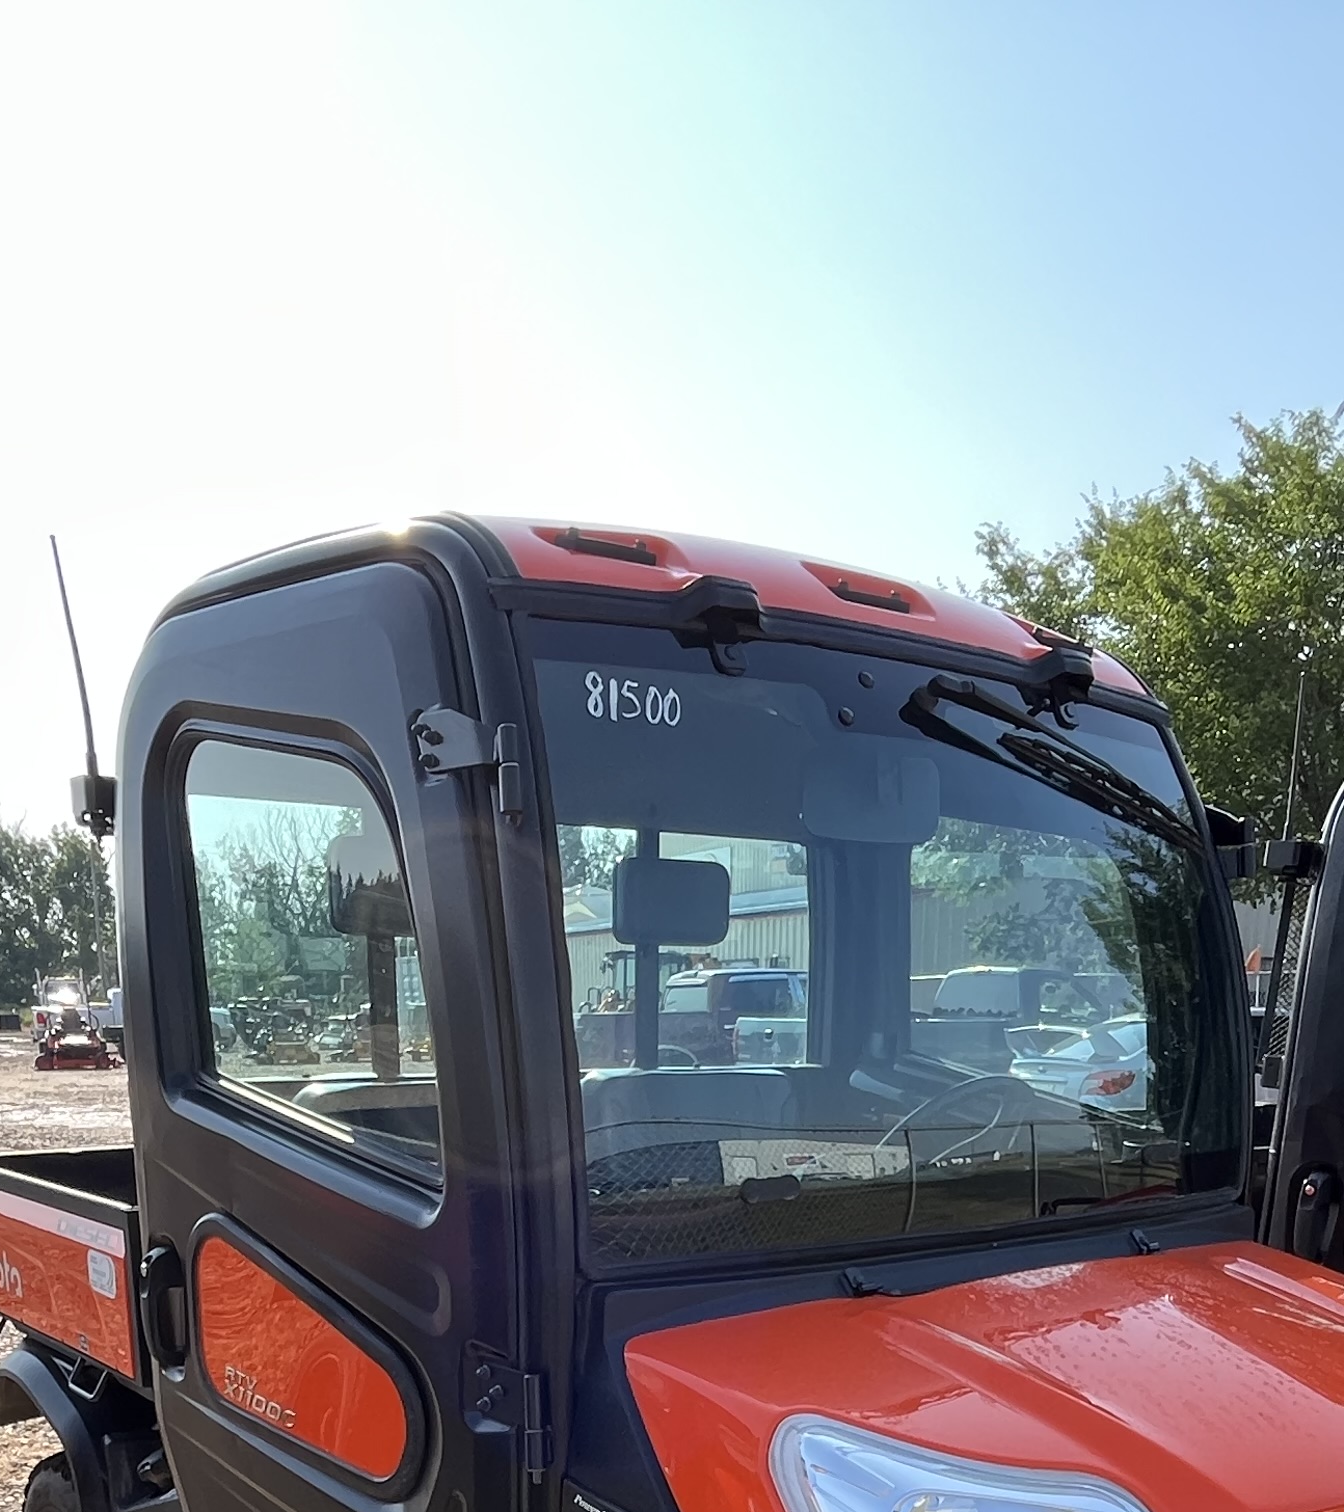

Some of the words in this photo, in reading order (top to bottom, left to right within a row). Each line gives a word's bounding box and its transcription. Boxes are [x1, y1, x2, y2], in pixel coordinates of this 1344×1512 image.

[584, 670, 681, 727] 81500
[224, 1364, 258, 1391] RTV
[222, 1379, 297, 1429] X1100C
